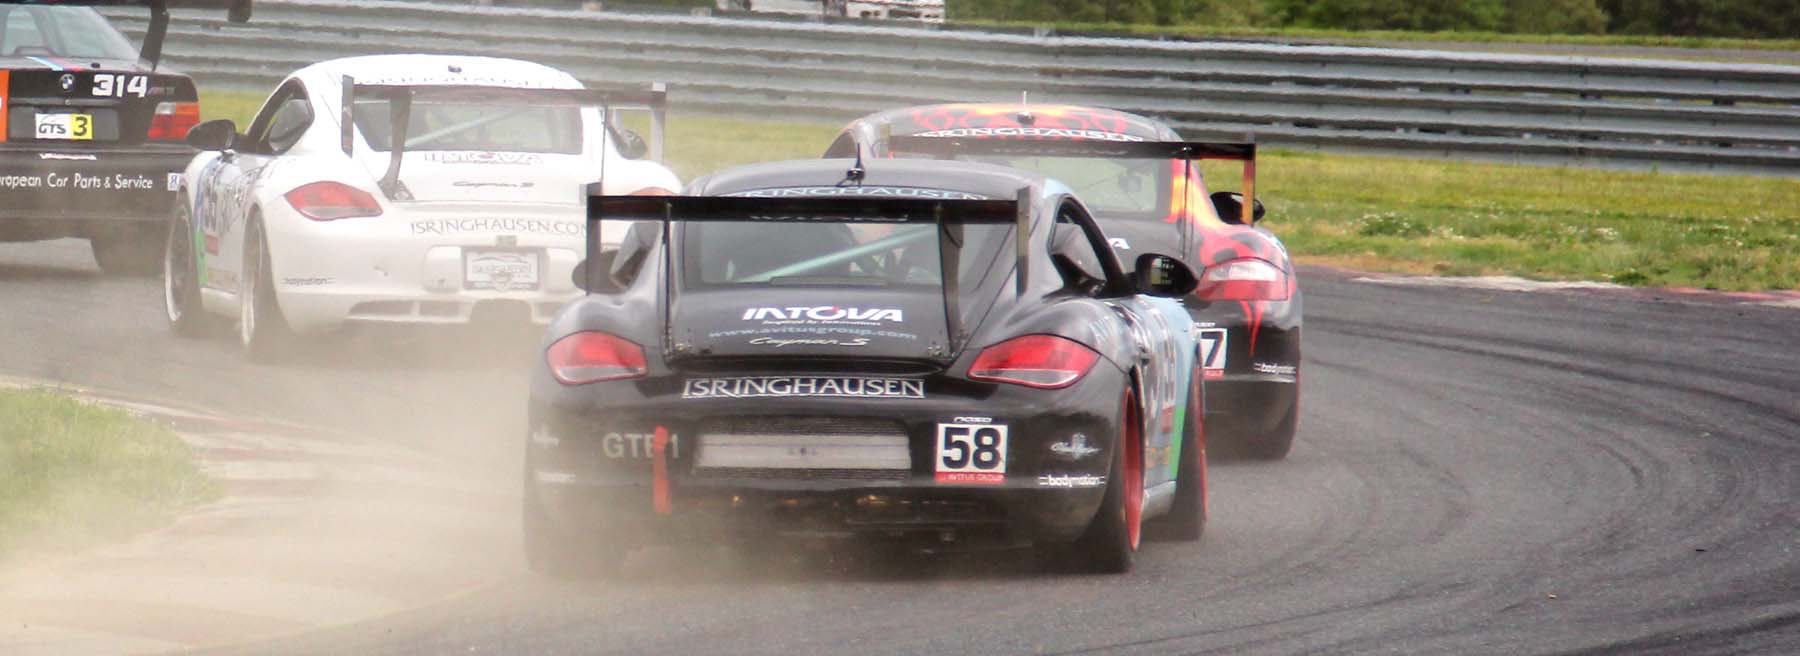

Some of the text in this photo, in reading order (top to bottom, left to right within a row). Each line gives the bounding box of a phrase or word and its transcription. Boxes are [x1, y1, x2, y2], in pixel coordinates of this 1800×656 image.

[92, 74, 148, 98] 314
[38, 116, 88, 137] GTS 3
[0, 173, 41, 190] ropean
[47, 172, 68, 188] Car
[73, 172, 101, 189] Parts
[114, 174, 153, 190] Service
[741, 306, 904, 323] INTOVA
[708, 325, 918, 339] www.avitusgroup.com
[749, 337, 870, 347] Cayman S
[682, 378, 925, 398] ISRINGHAUSEN
[942, 427, 1001, 470] 58
